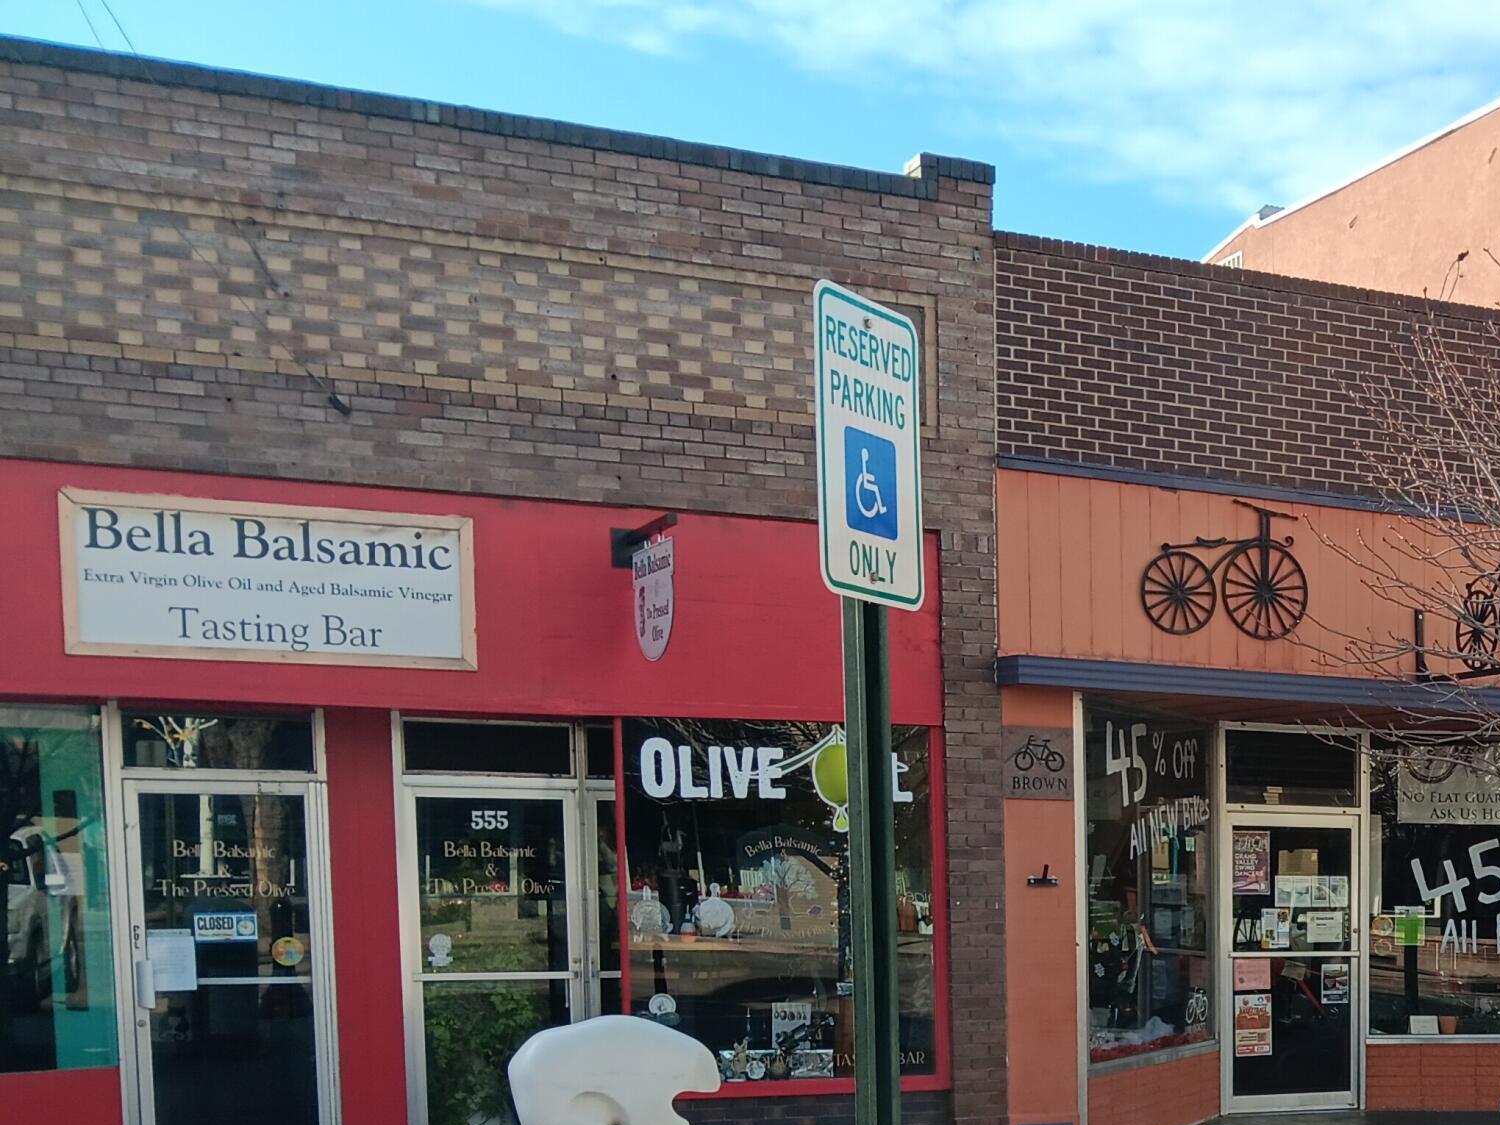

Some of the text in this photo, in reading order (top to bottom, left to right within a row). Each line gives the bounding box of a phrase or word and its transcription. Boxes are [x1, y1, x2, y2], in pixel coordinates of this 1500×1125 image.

[826, 315, 911, 383] RESERVED
[830, 369, 905, 430] PARKING
[81, 506, 452, 570] Bella Balsamic
[849, 539, 896, 585] ONLY
[83, 568, 453, 603] Extra Virgin Olive Oil and Aged Balsamic Vinegar
[168, 606, 383, 652] Tasting Bar
[640, 737, 786, 799] OLIVE
[1012, 775, 1068, 791] BROWN
[1402, 792, 1425, 802] NO
[1430, 792, 1460, 804] FLAT
[471, 810, 509, 830] 555
[1430, 808, 1456, 819] ASK
[1460, 808, 1477, 819] US
[1149, 801, 1179, 849] NEW
[173, 840, 276, 859] Bell Balsamic
[444, 841, 537, 858] Bella Balsamic
[774, 835, 823, 855] Balsamic
[485, 863, 500, 877] &
[156, 878, 296, 897] The Pressed Olive
[429, 878, 555, 895] Te Presse Olive
[197, 916, 234, 930] CLOSED
[1440, 919, 1477, 954] All
